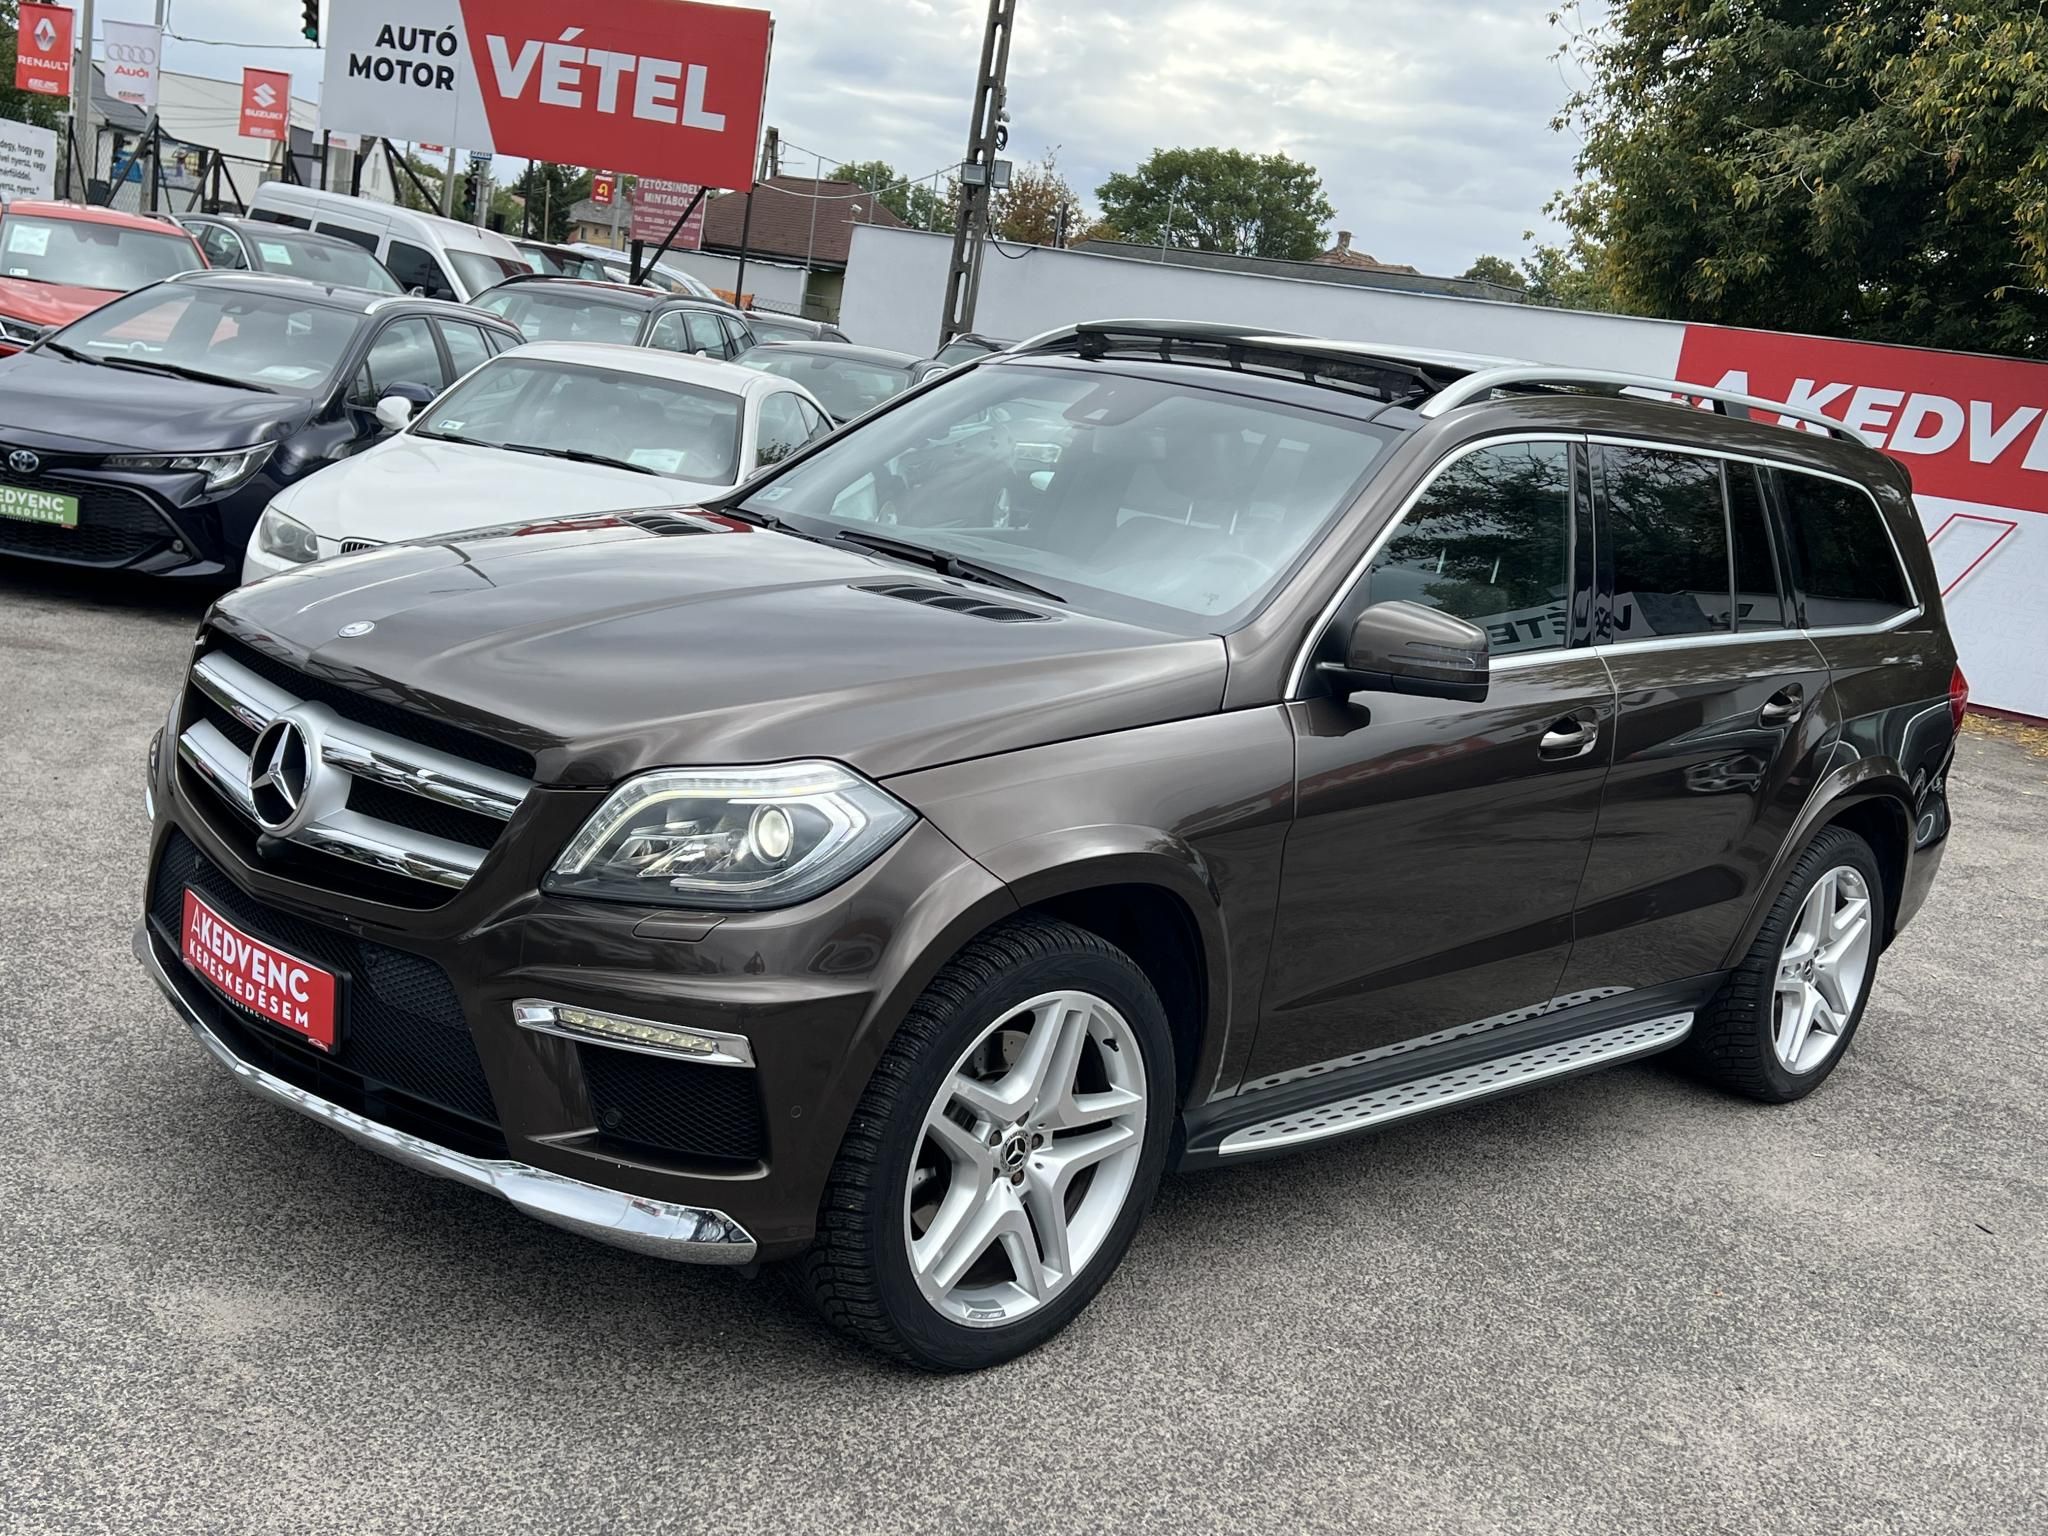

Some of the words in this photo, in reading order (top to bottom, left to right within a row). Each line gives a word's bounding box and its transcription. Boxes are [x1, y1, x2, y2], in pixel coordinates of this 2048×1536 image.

[375, 24, 458, 57] AUTÓ
[17, 55, 69, 71] RENAULT
[348, 53, 455, 91] MOTOR
[485, 27, 726, 132] VÉTEL
[245, 108, 282, 120] SUZUKI
[189, 938, 309, 1029] KERESKEDÉSEM
